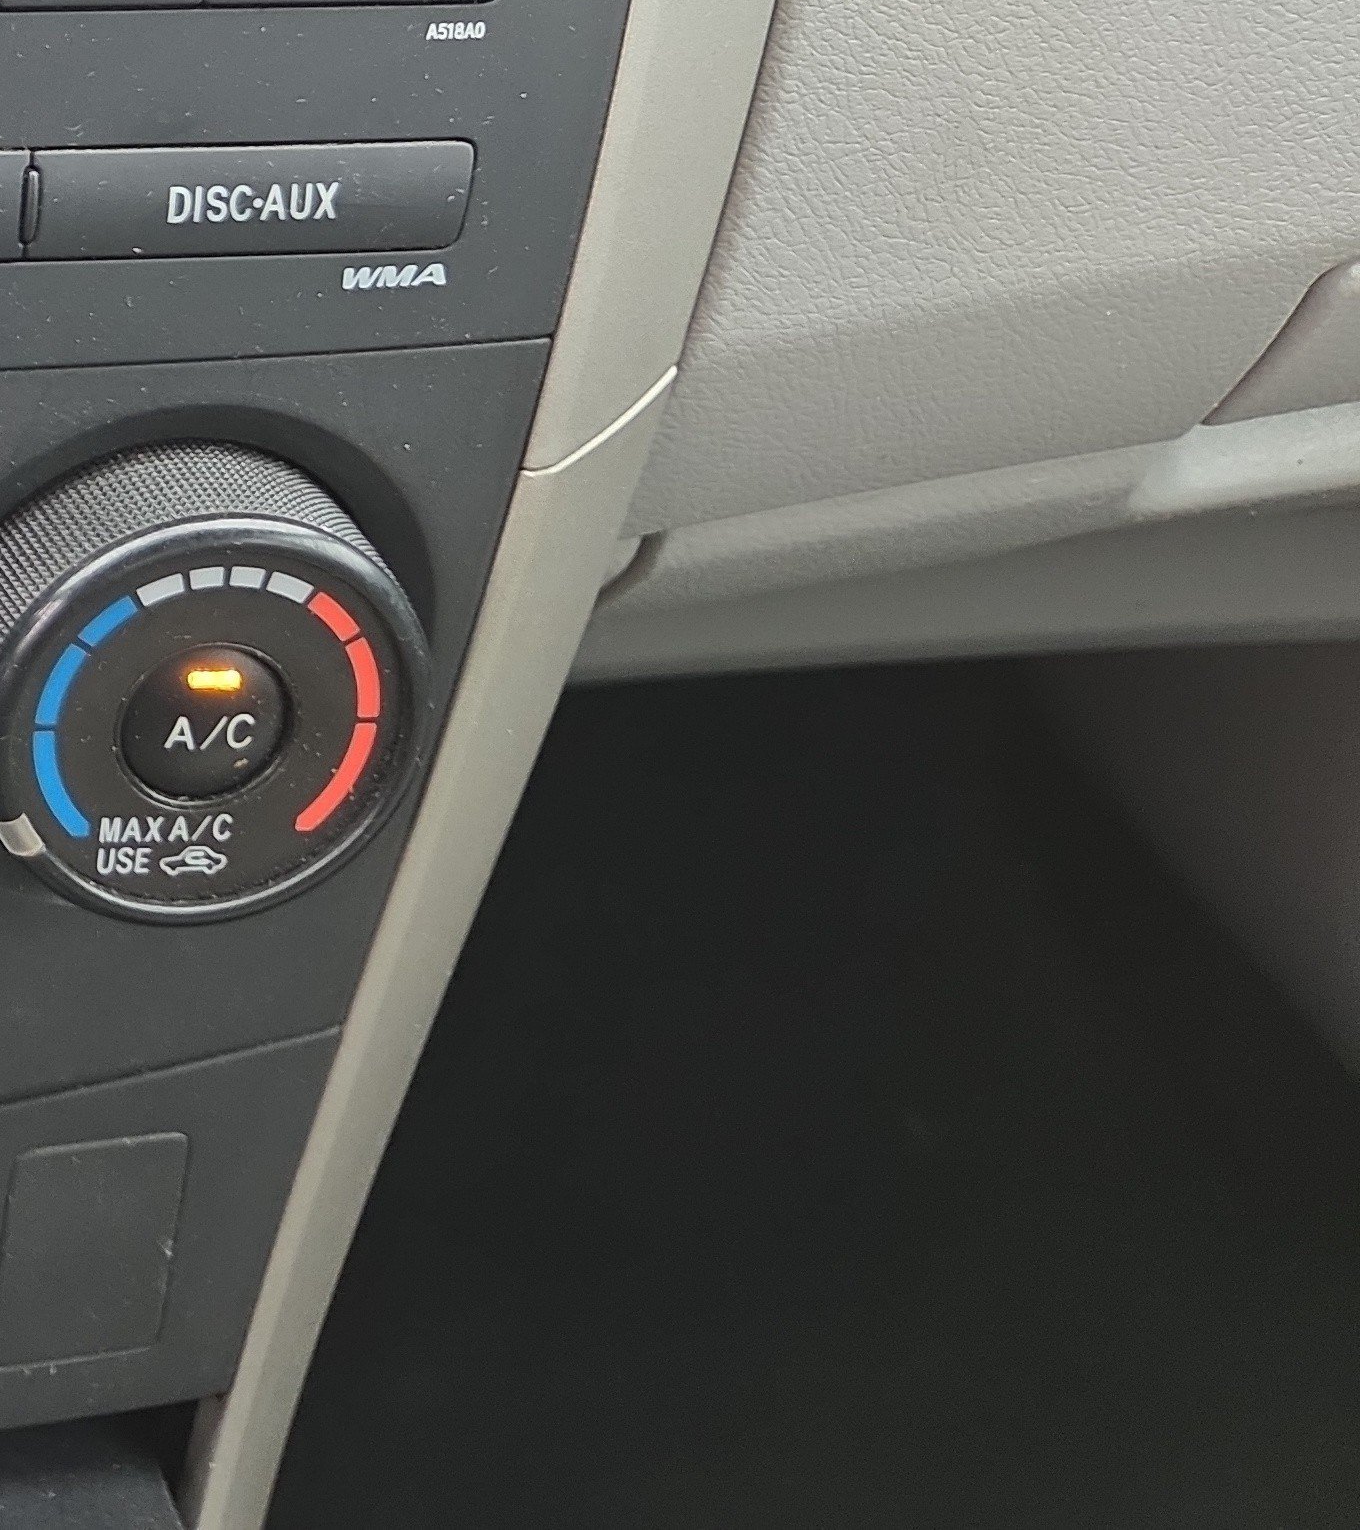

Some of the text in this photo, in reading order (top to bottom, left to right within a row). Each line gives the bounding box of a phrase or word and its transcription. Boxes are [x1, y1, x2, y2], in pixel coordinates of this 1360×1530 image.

[341, 262, 447, 291] WMA
[164, 714, 256, 751] A/C
[98, 813, 233, 843] MAX A/C
[95, 847, 152, 875] USE
